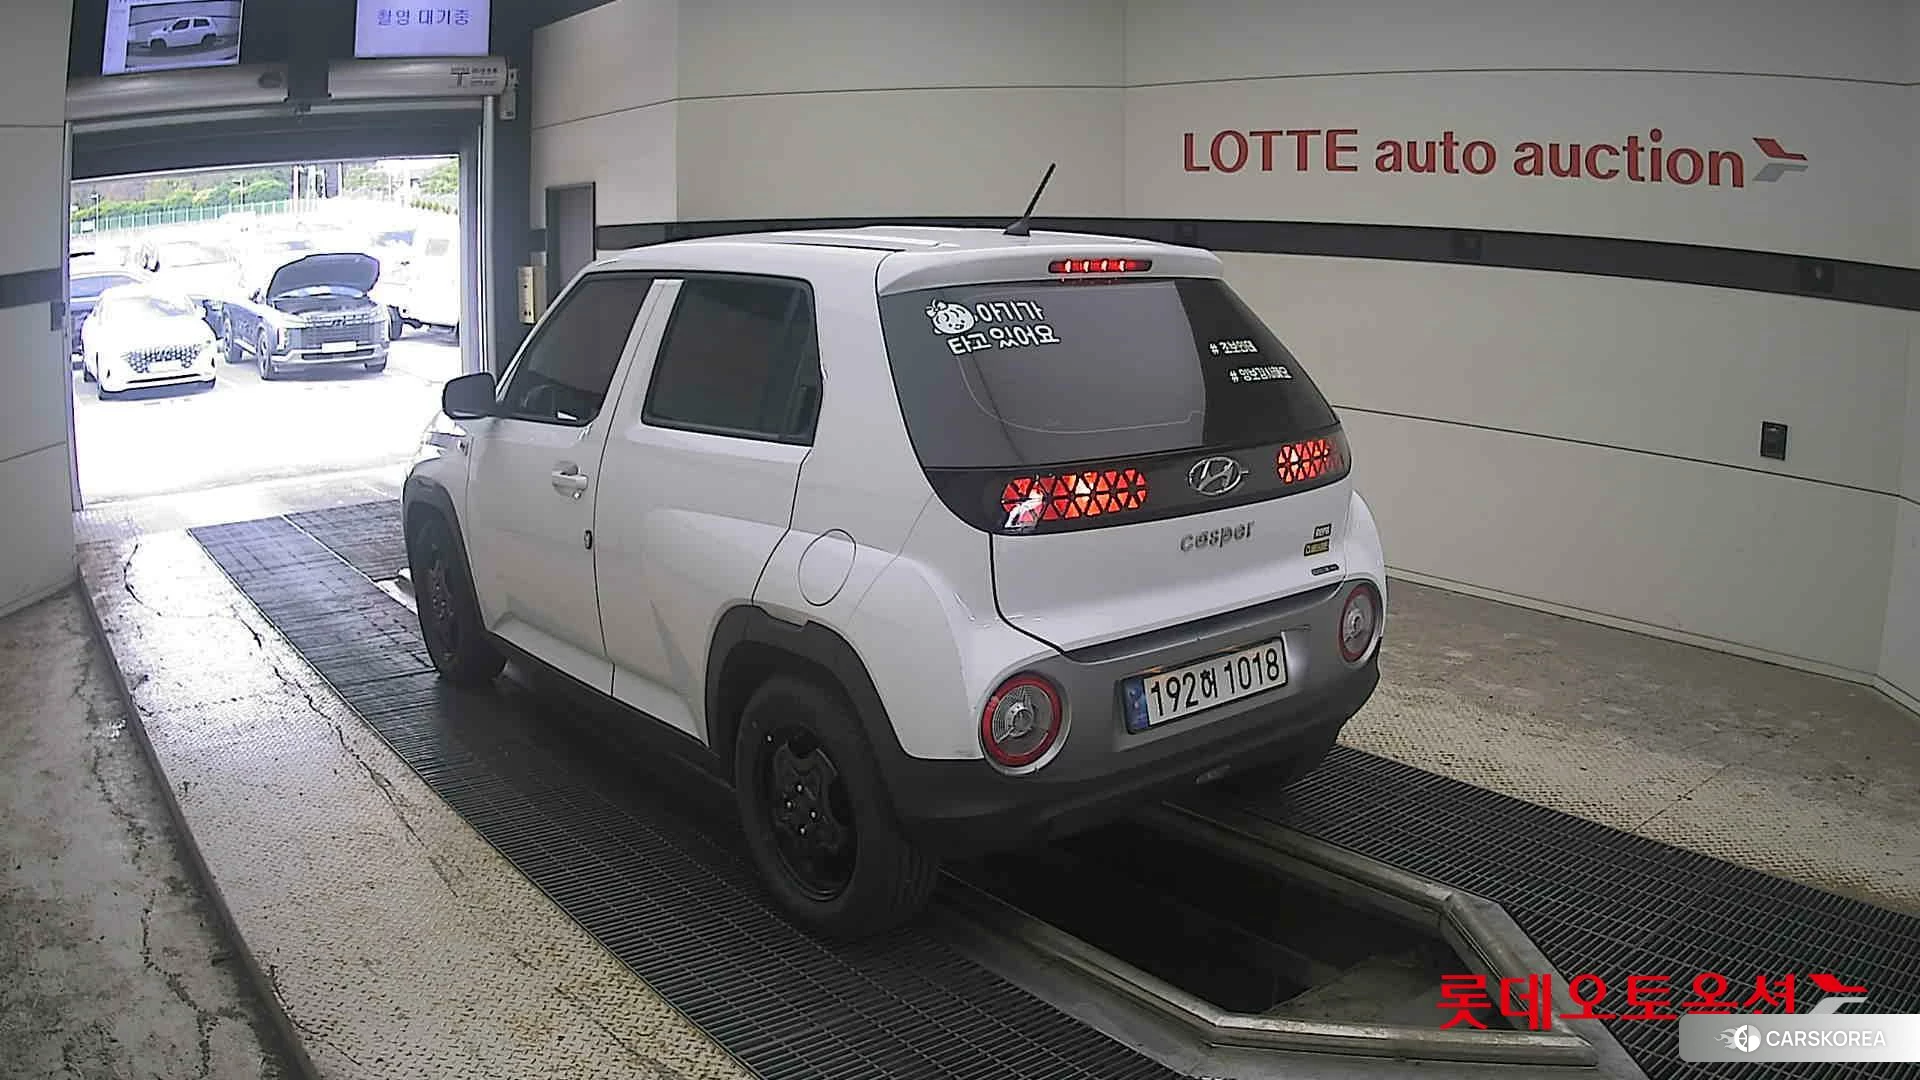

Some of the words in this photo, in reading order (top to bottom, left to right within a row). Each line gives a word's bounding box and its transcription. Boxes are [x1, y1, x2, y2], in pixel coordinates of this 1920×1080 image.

[417, 8, 473, 26] 대기중
[1184, 129, 1359, 173] LOTTE
[1375, 131, 1496, 175] auto
[1514, 128, 1744, 188] auction
[975, 301, 1044, 323] 아기가
[947, 332, 992, 354] 타고
[988, 325, 1061, 349] 있어요
[1150, 667, 1218, 716] 192허
[1223, 647, 1280, 695] 1018
